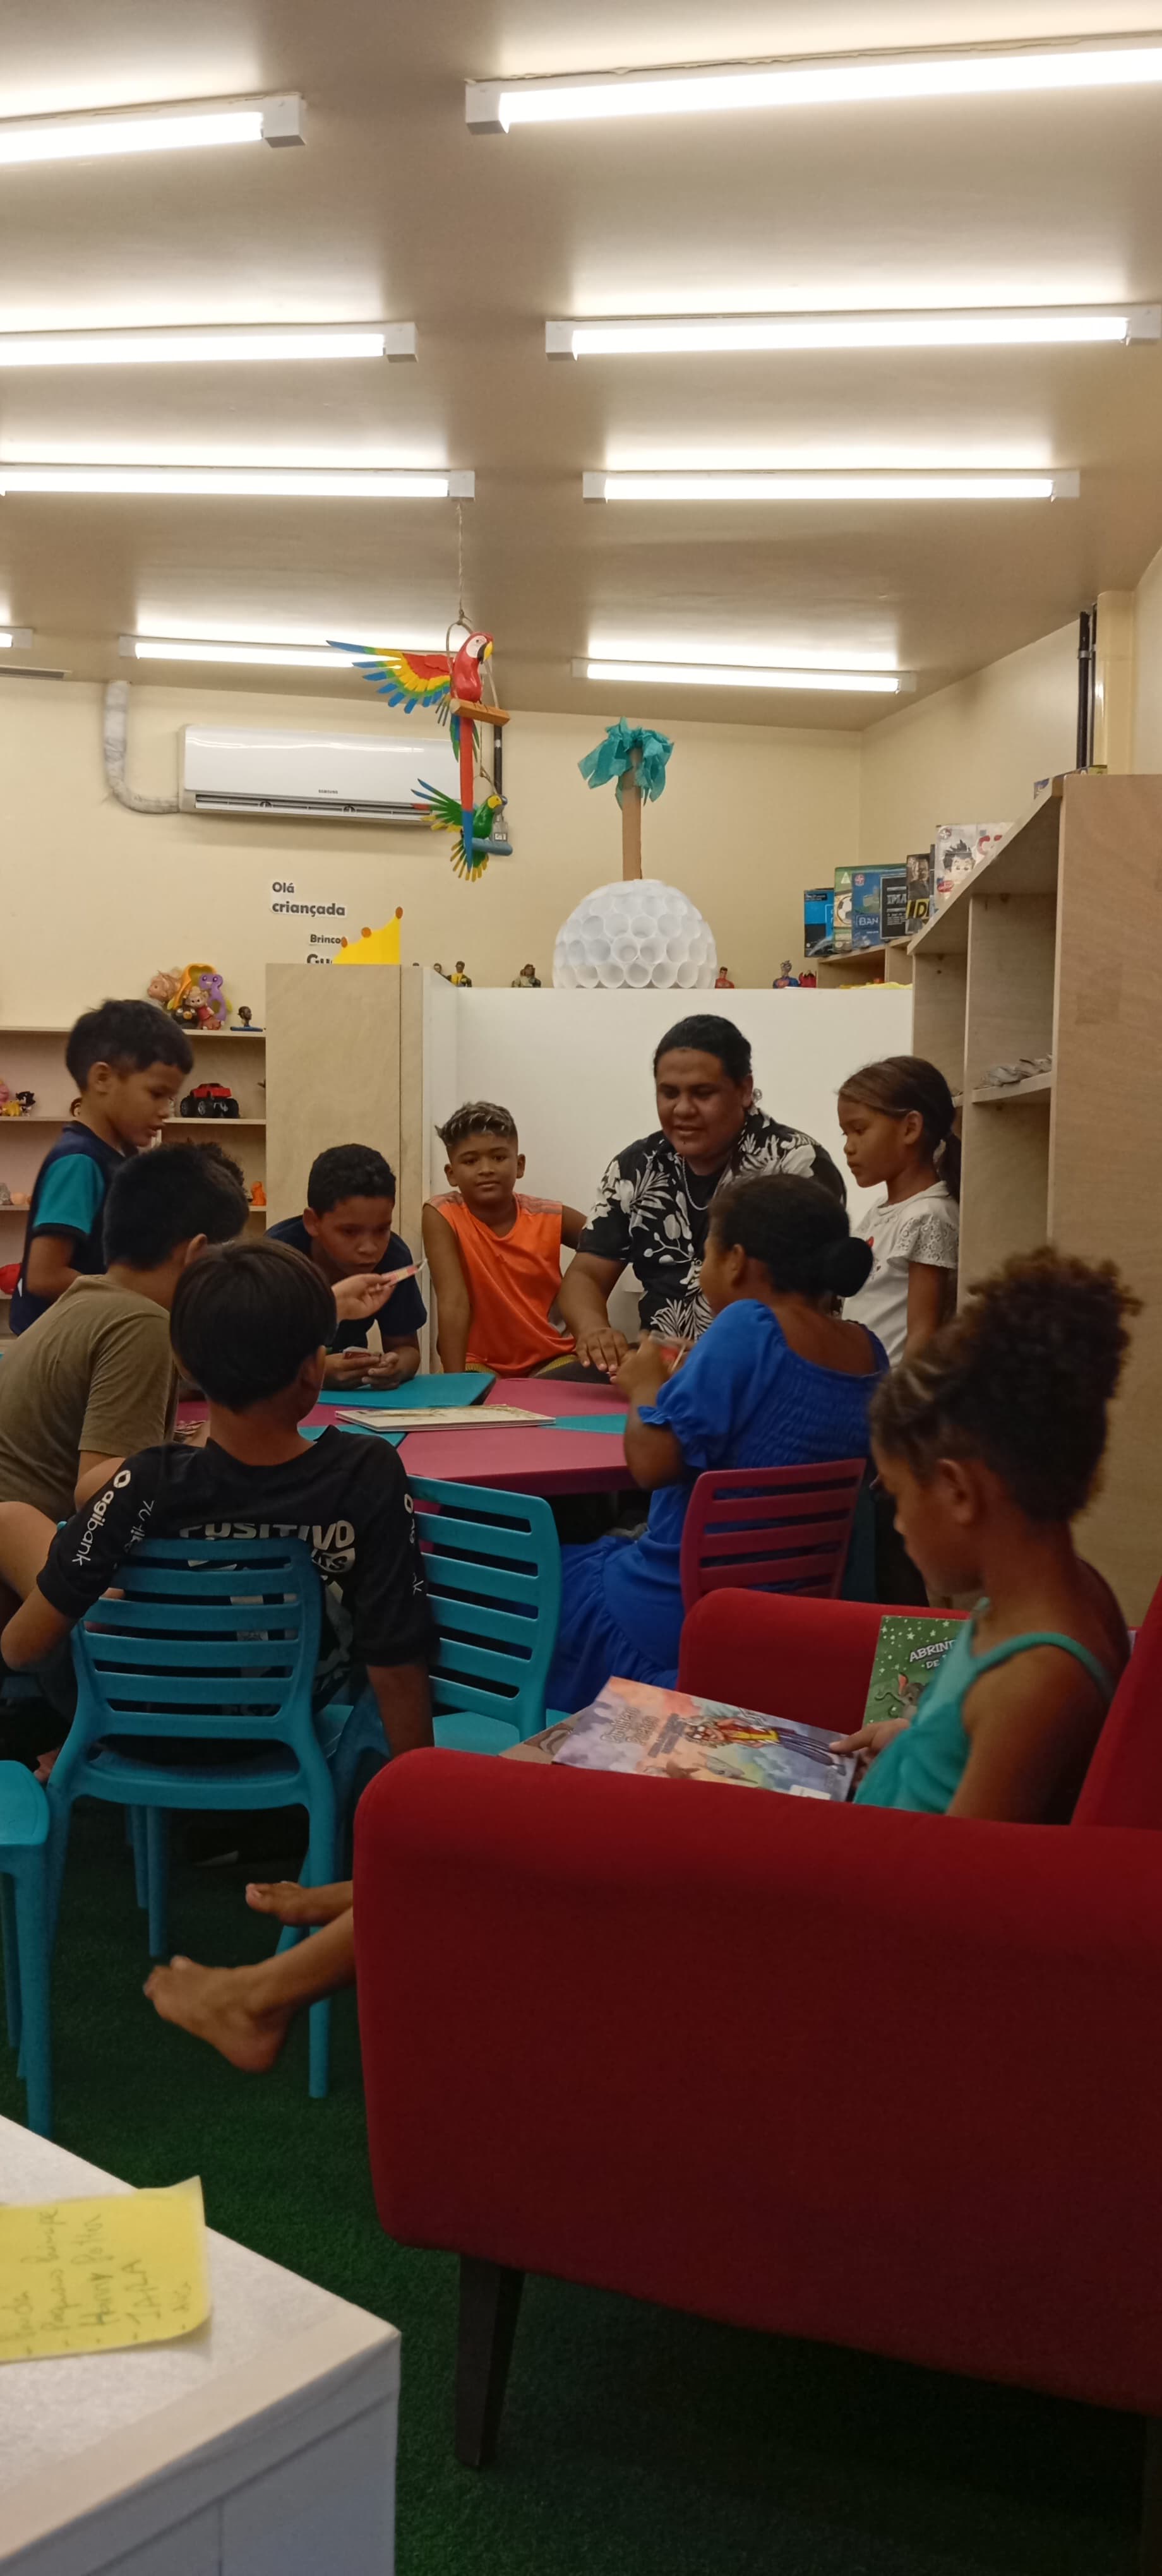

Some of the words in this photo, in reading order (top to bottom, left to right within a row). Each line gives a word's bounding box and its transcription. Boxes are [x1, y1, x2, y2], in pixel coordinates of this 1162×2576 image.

[272, 882, 294, 893] Olá
[272, 901, 345, 917] criançada
[72, 1491, 114, 1566] agibank
